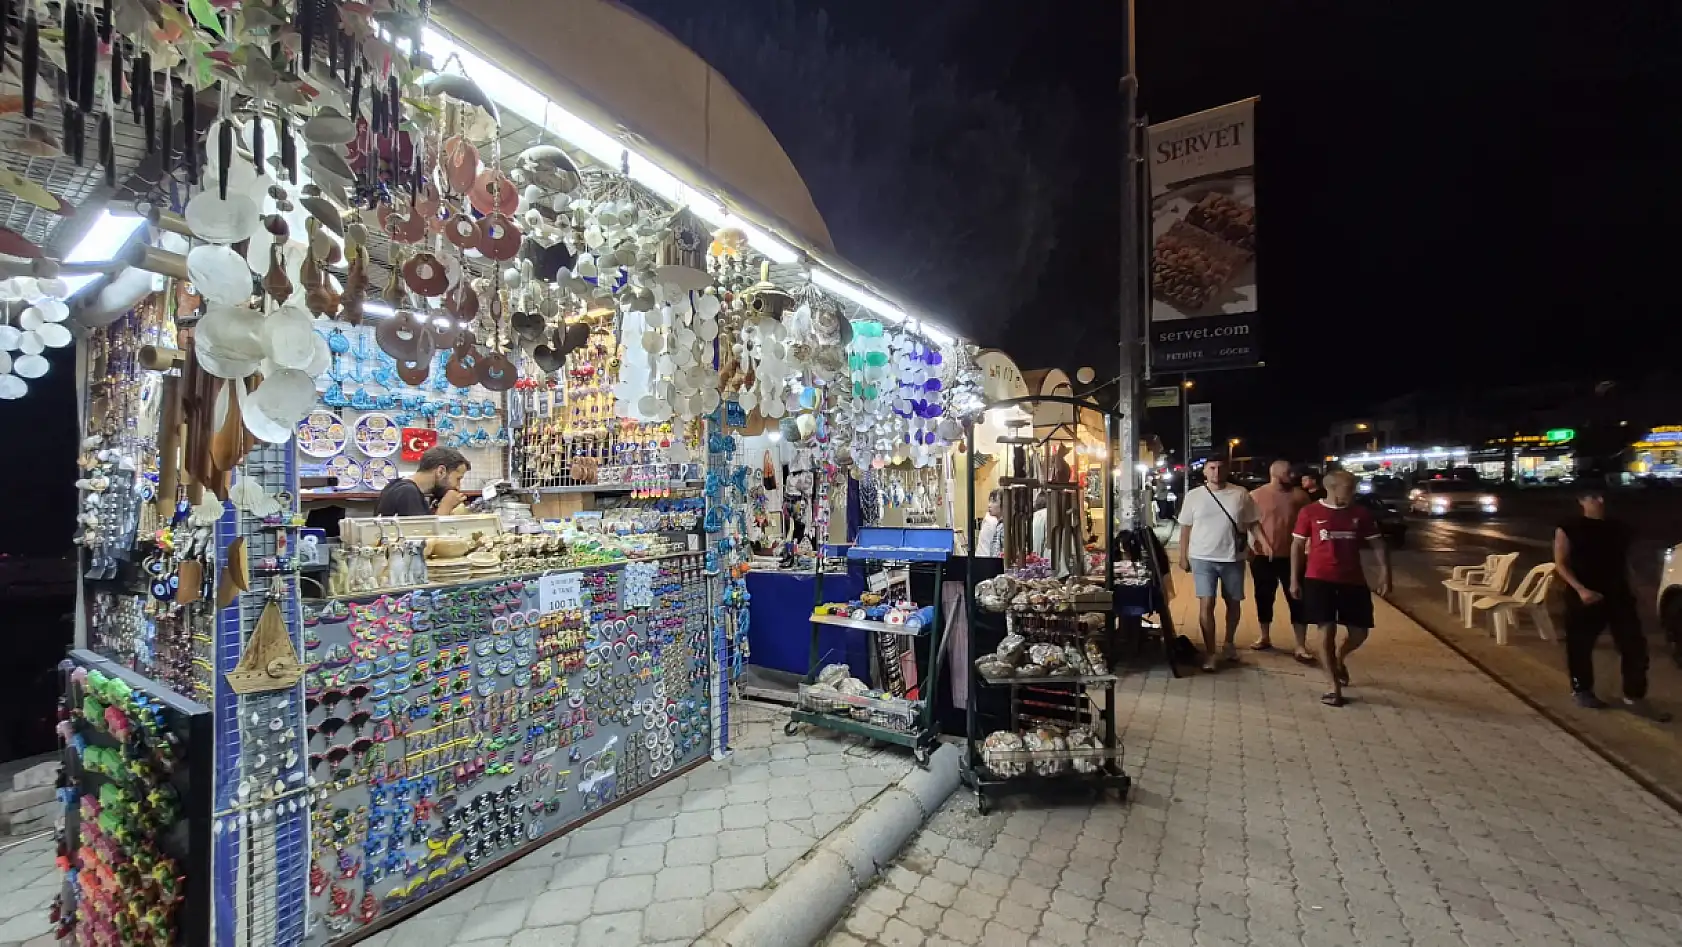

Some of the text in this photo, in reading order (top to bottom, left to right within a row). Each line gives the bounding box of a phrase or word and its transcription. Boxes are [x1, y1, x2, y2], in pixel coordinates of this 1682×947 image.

[1156, 121, 1244, 165] SERVET
[1159, 324, 1249, 342] servet.com
[550, 600, 566, 610] 100
